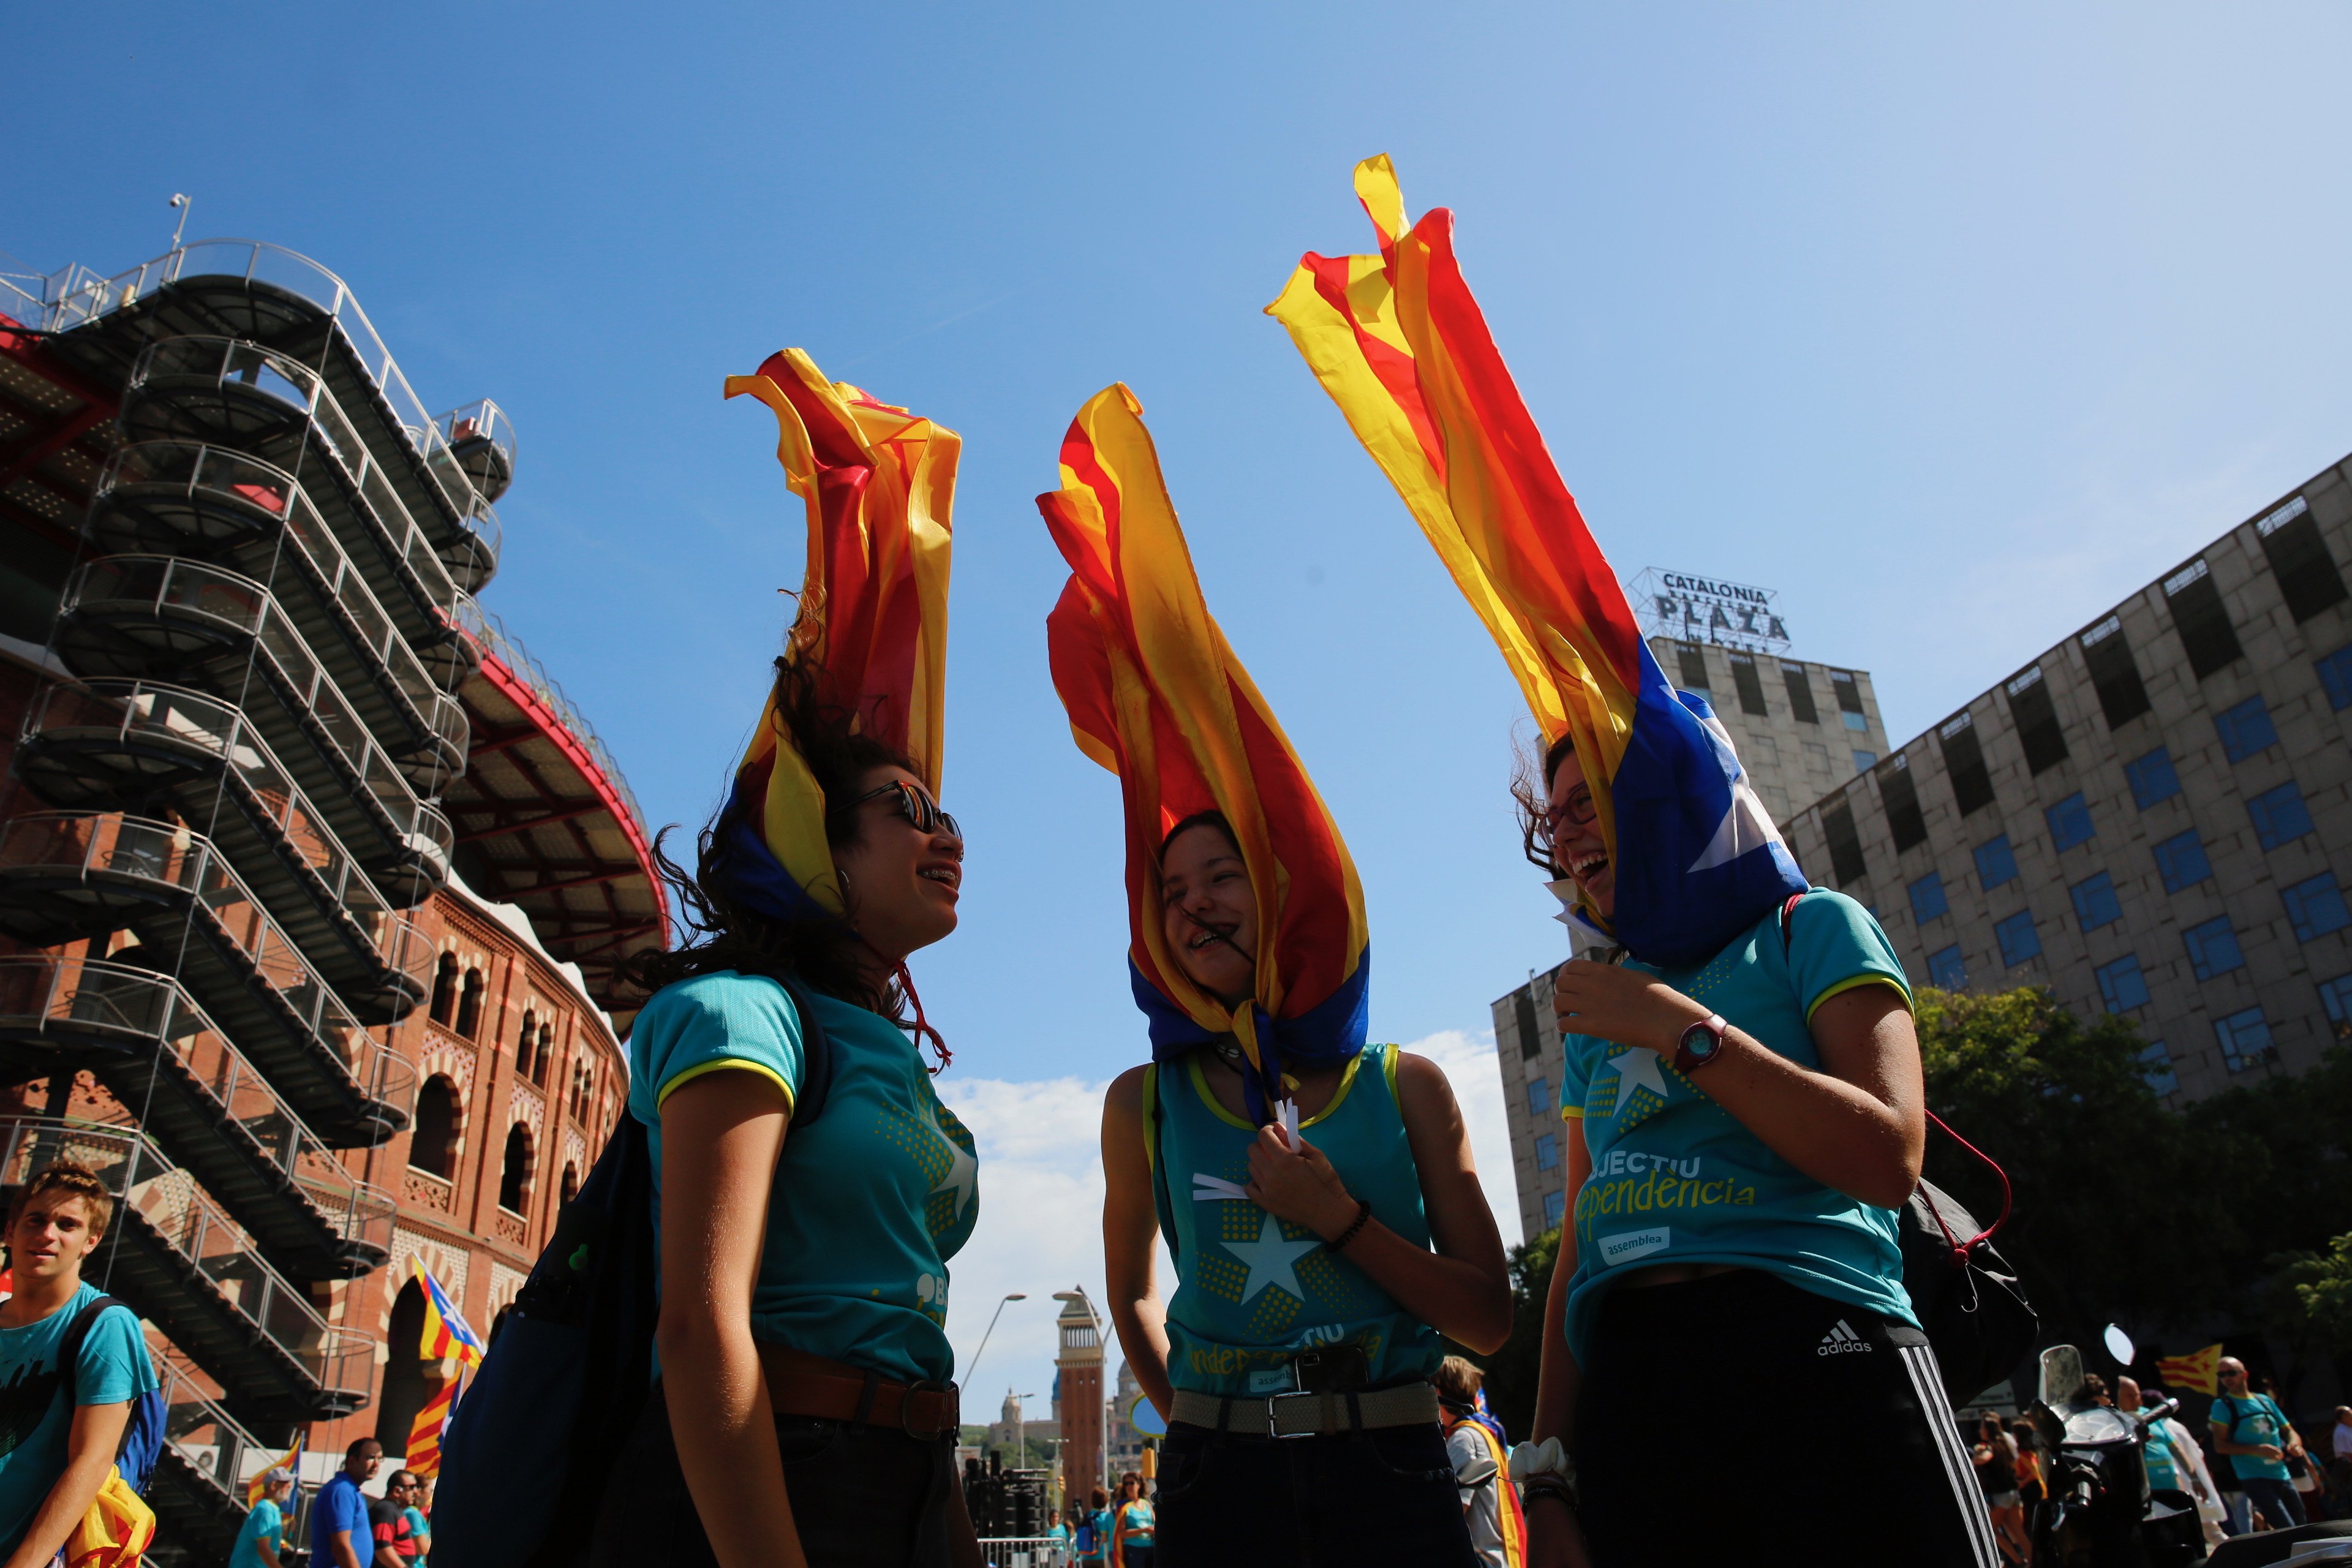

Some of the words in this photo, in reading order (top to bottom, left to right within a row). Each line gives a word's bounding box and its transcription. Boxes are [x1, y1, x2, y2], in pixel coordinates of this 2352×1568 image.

[1664, 574, 1768, 605] CATALONIA
[1657, 597, 1790, 640] PLAZA
[1575, 1169, 1755, 1242] ependència
[1608, 1235, 1662, 1255] assemblea
[1817, 1340, 1872, 1356] adidas
